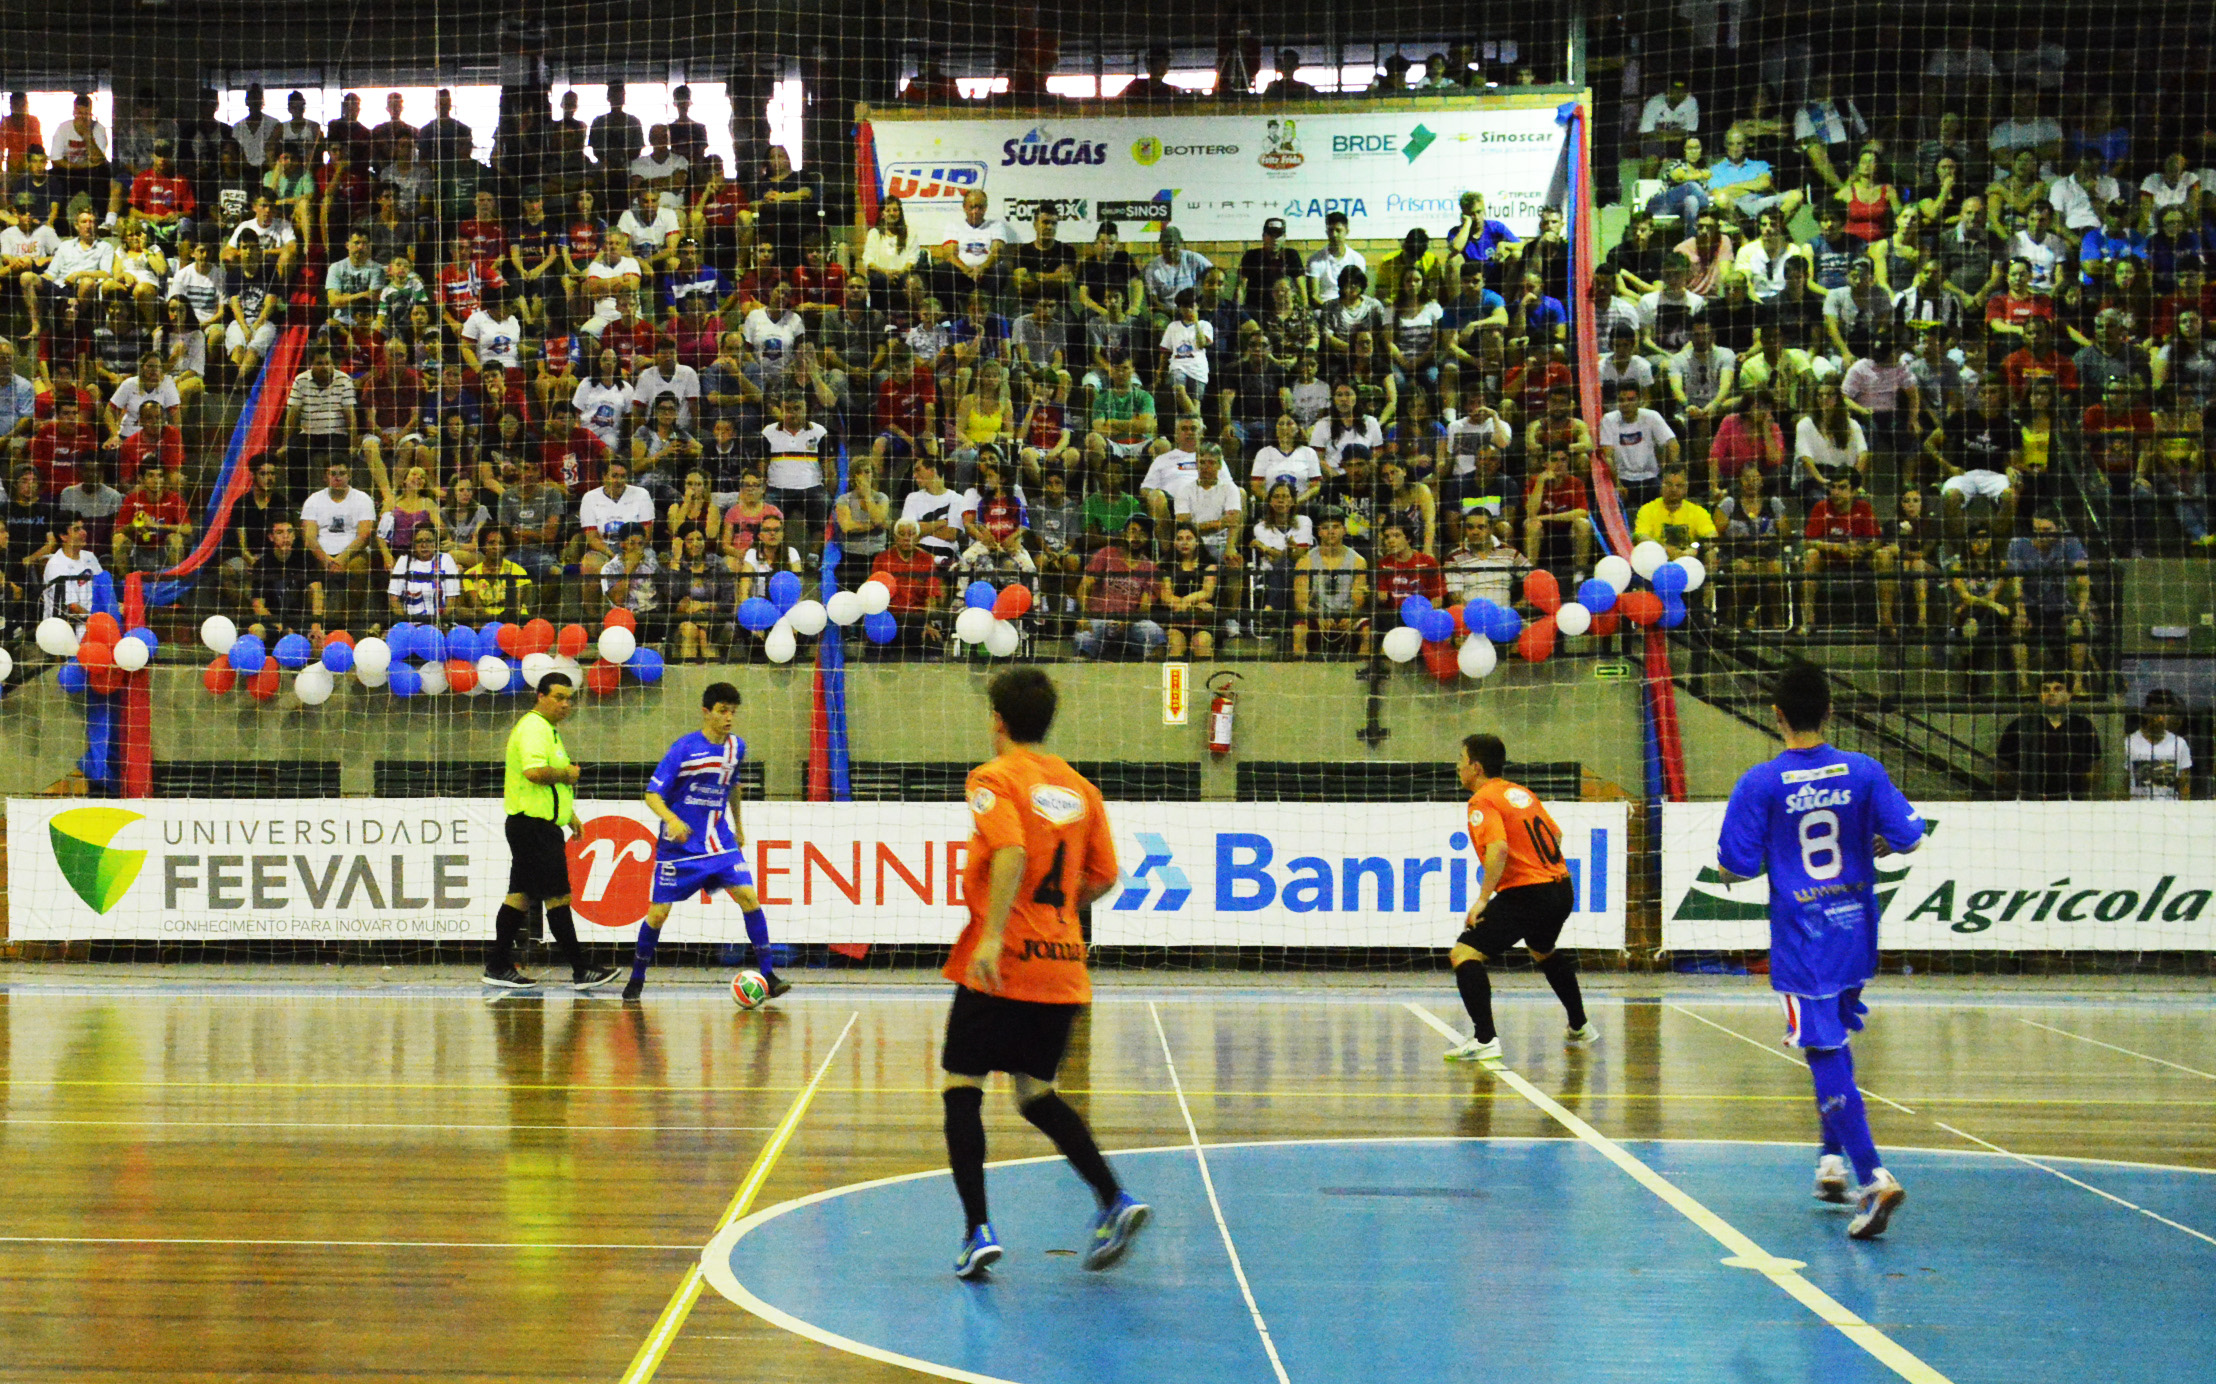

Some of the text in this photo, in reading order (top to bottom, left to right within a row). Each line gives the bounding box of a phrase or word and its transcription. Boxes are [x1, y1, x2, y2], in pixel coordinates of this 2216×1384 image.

[1332, 134, 1398, 152] BRDE
[1481, 131, 1553, 143] Sinoscar
[1164, 145, 1239, 156] BOTTERO
[1004, 198, 1079, 220] Forax
[1126, 204, 1168, 217] SINOS
[1187, 201, 1278, 210] WIRTH
[1306, 198, 1368, 218] APTA
[1387, 193, 1454, 212] Prisma
[1484, 201, 1514, 217] tual
[163, 819, 470, 844] UNIVERSIDADE
[1523, 815, 1561, 866] 10
[1799, 809, 1843, 880] 8
[698, 840, 969, 905] ENNE
[1033, 838, 1067, 908] 4
[1215, 828, 1608, 913] Banril
[164, 855, 471, 909] FEEVALE
[1905, 875, 2214, 933] Agrícola
[164, 919, 470, 933] CONHECIMENTO PARA INOVAR O MUNDO
